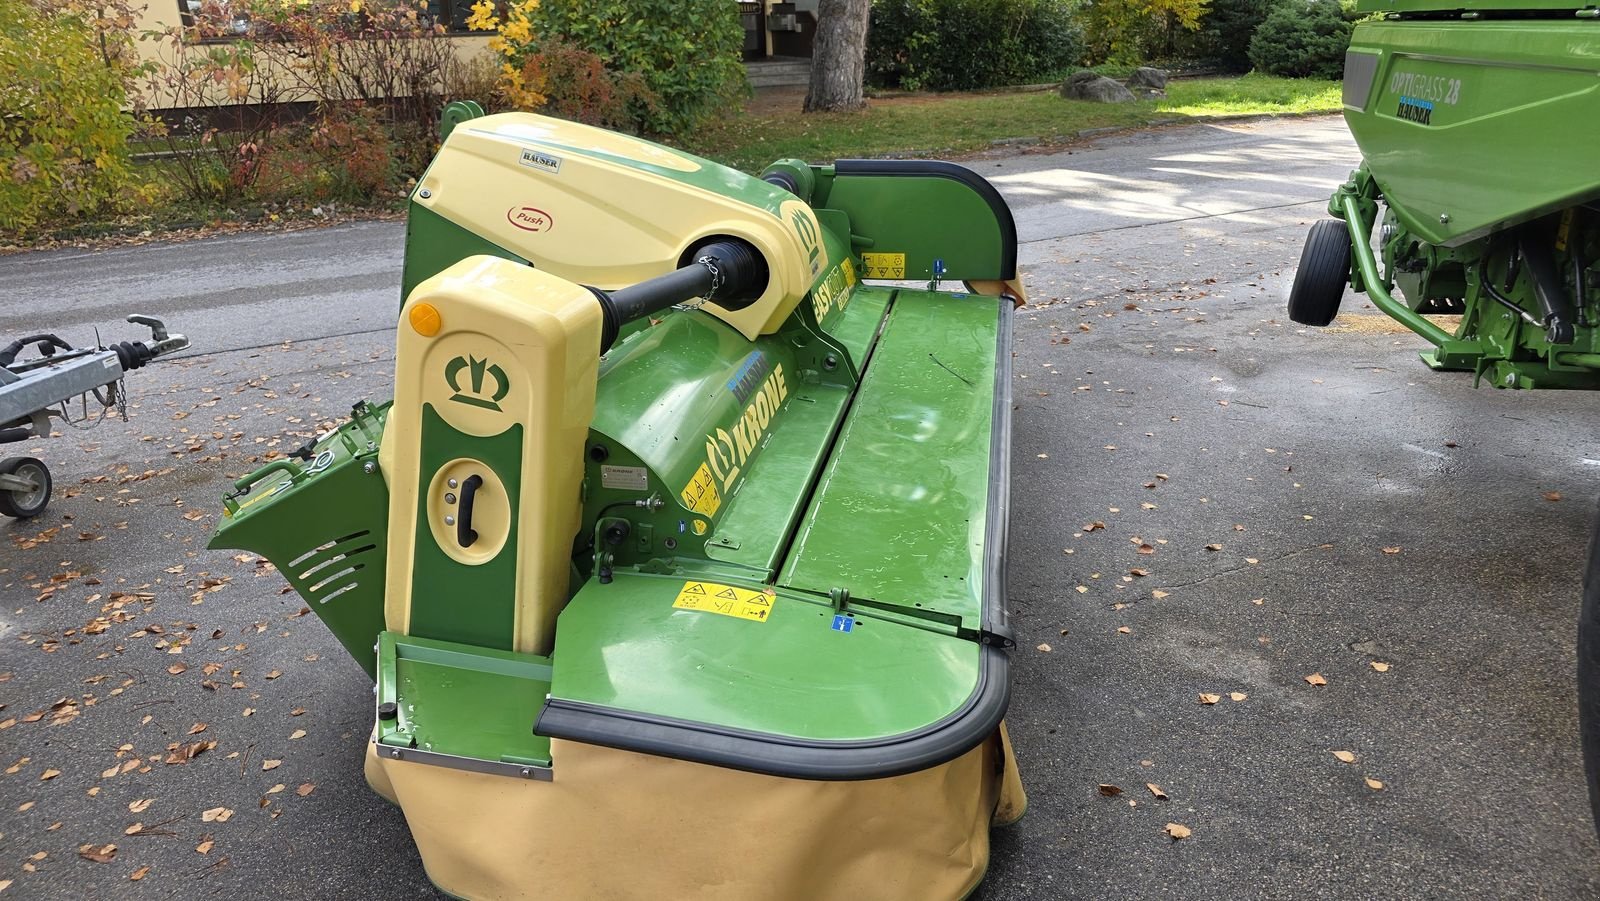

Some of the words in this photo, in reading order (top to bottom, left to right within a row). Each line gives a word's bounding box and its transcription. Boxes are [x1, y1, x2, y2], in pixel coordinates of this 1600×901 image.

[1390, 71, 1446, 103] OPTIGRASS
[1443, 78, 1462, 105] 28
[1396, 102, 1433, 126] HAUSER
[522, 151, 558, 169] HAUSER
[516, 212, 544, 226] Push
[732, 362, 788, 467] KRONE
